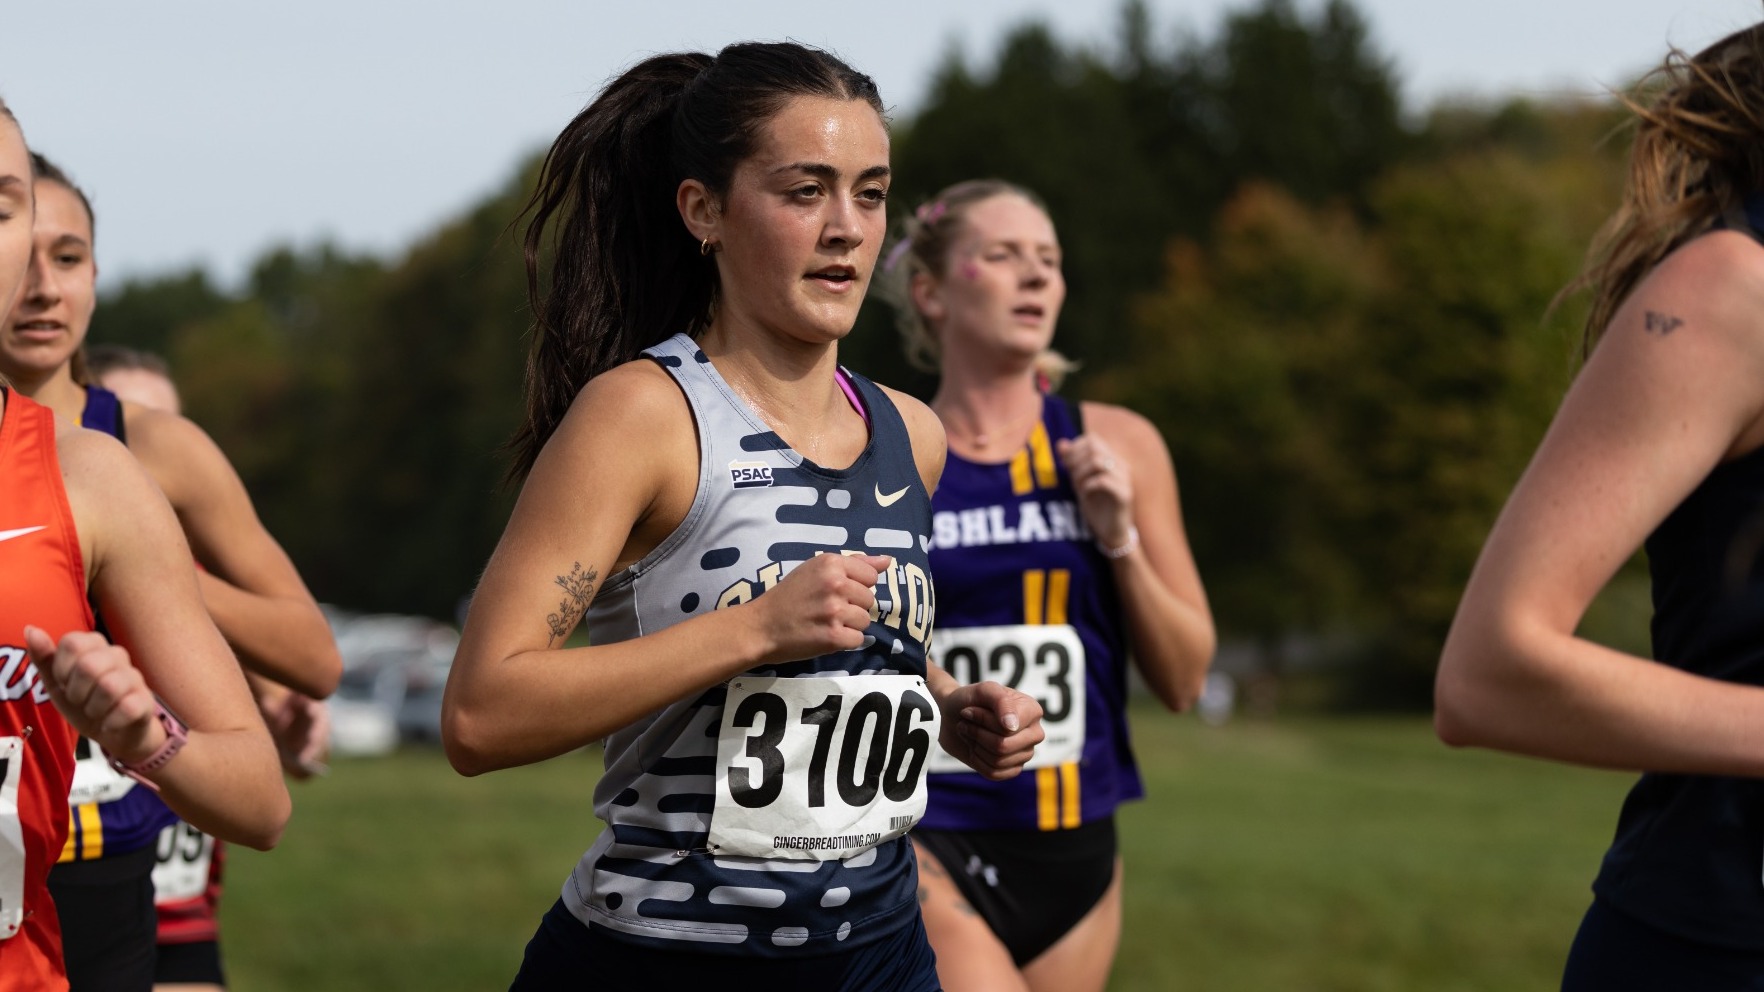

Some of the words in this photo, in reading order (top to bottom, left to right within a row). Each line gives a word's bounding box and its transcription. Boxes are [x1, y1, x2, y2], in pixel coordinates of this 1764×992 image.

[731, 467, 772, 481] PSAC
[927, 500, 1093, 550] SHLAN
[929, 642, 1072, 723] 023
[728, 689, 934, 808] 3106
[773, 832, 881, 850] GINGERBREADTIMING.COM
